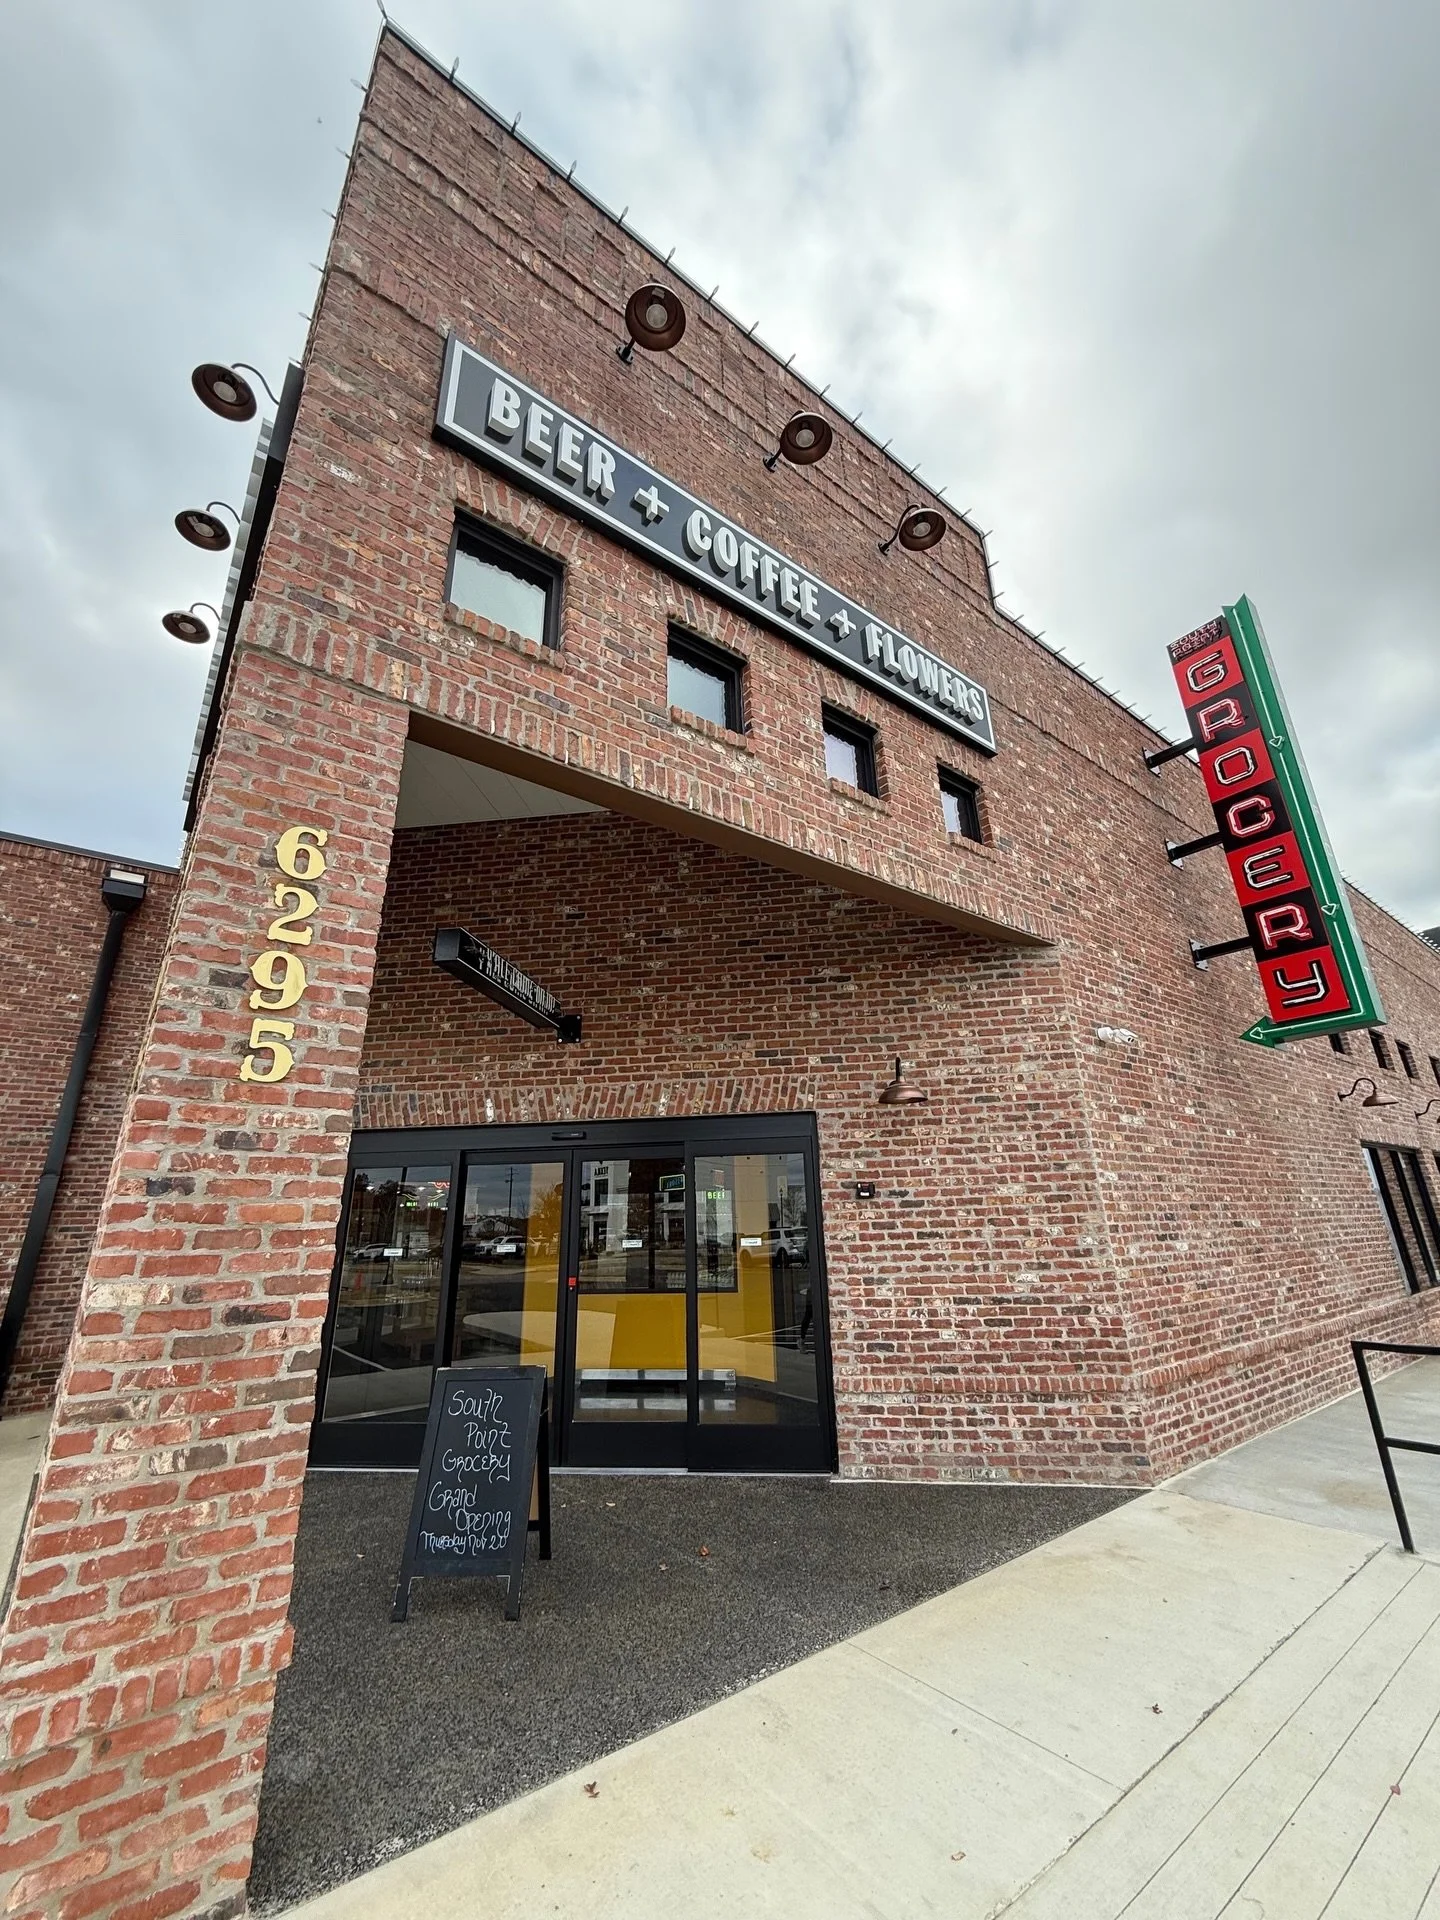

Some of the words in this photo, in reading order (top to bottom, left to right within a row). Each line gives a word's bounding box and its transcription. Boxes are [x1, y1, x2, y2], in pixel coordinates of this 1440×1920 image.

[487, 378, 616, 498] BEER
[686, 509, 822, 626] COFFEE
[865, 622, 984, 723] FLOWERS
[240, 826, 329, 1083] 6295
[1185, 651, 1328, 1007] GROCERY
[448, 1389, 504, 1423] South
[464, 1422, 512, 1455] Point
